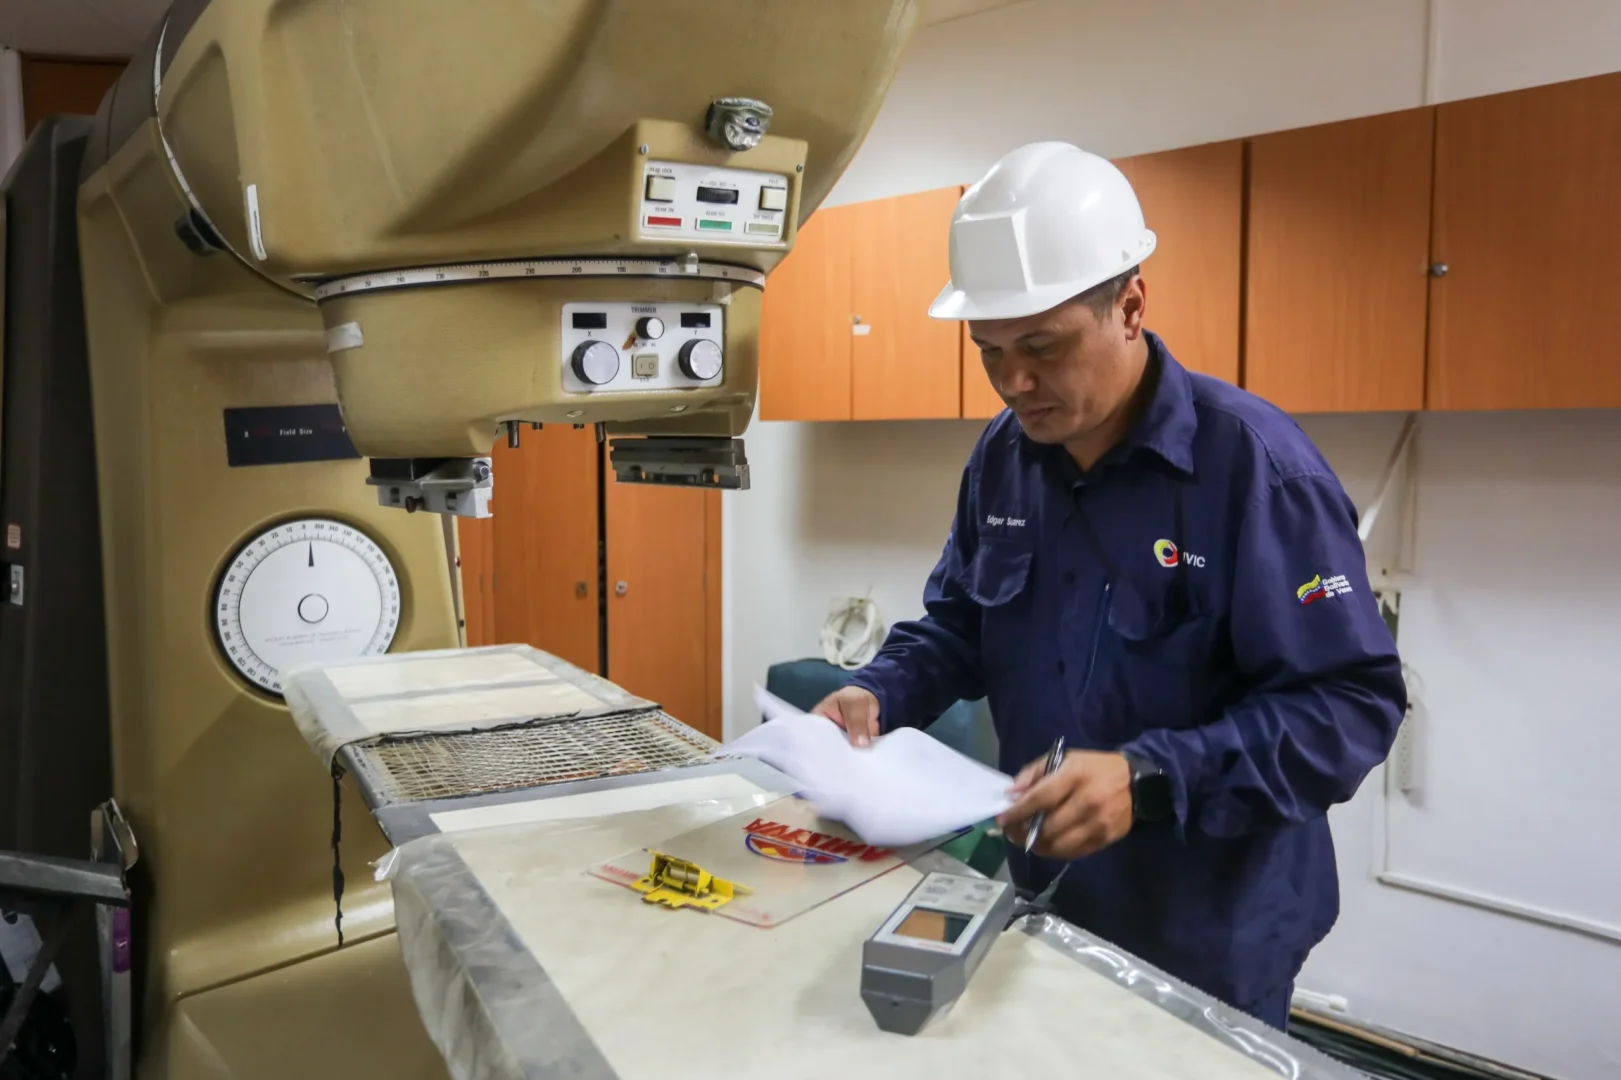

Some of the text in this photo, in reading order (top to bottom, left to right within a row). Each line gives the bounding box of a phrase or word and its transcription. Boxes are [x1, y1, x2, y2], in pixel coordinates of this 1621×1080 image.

[280, 428, 296, 436] Field
[987, 515, 1005, 526] Edgar
[1183, 551, 1206, 568] IVIC
